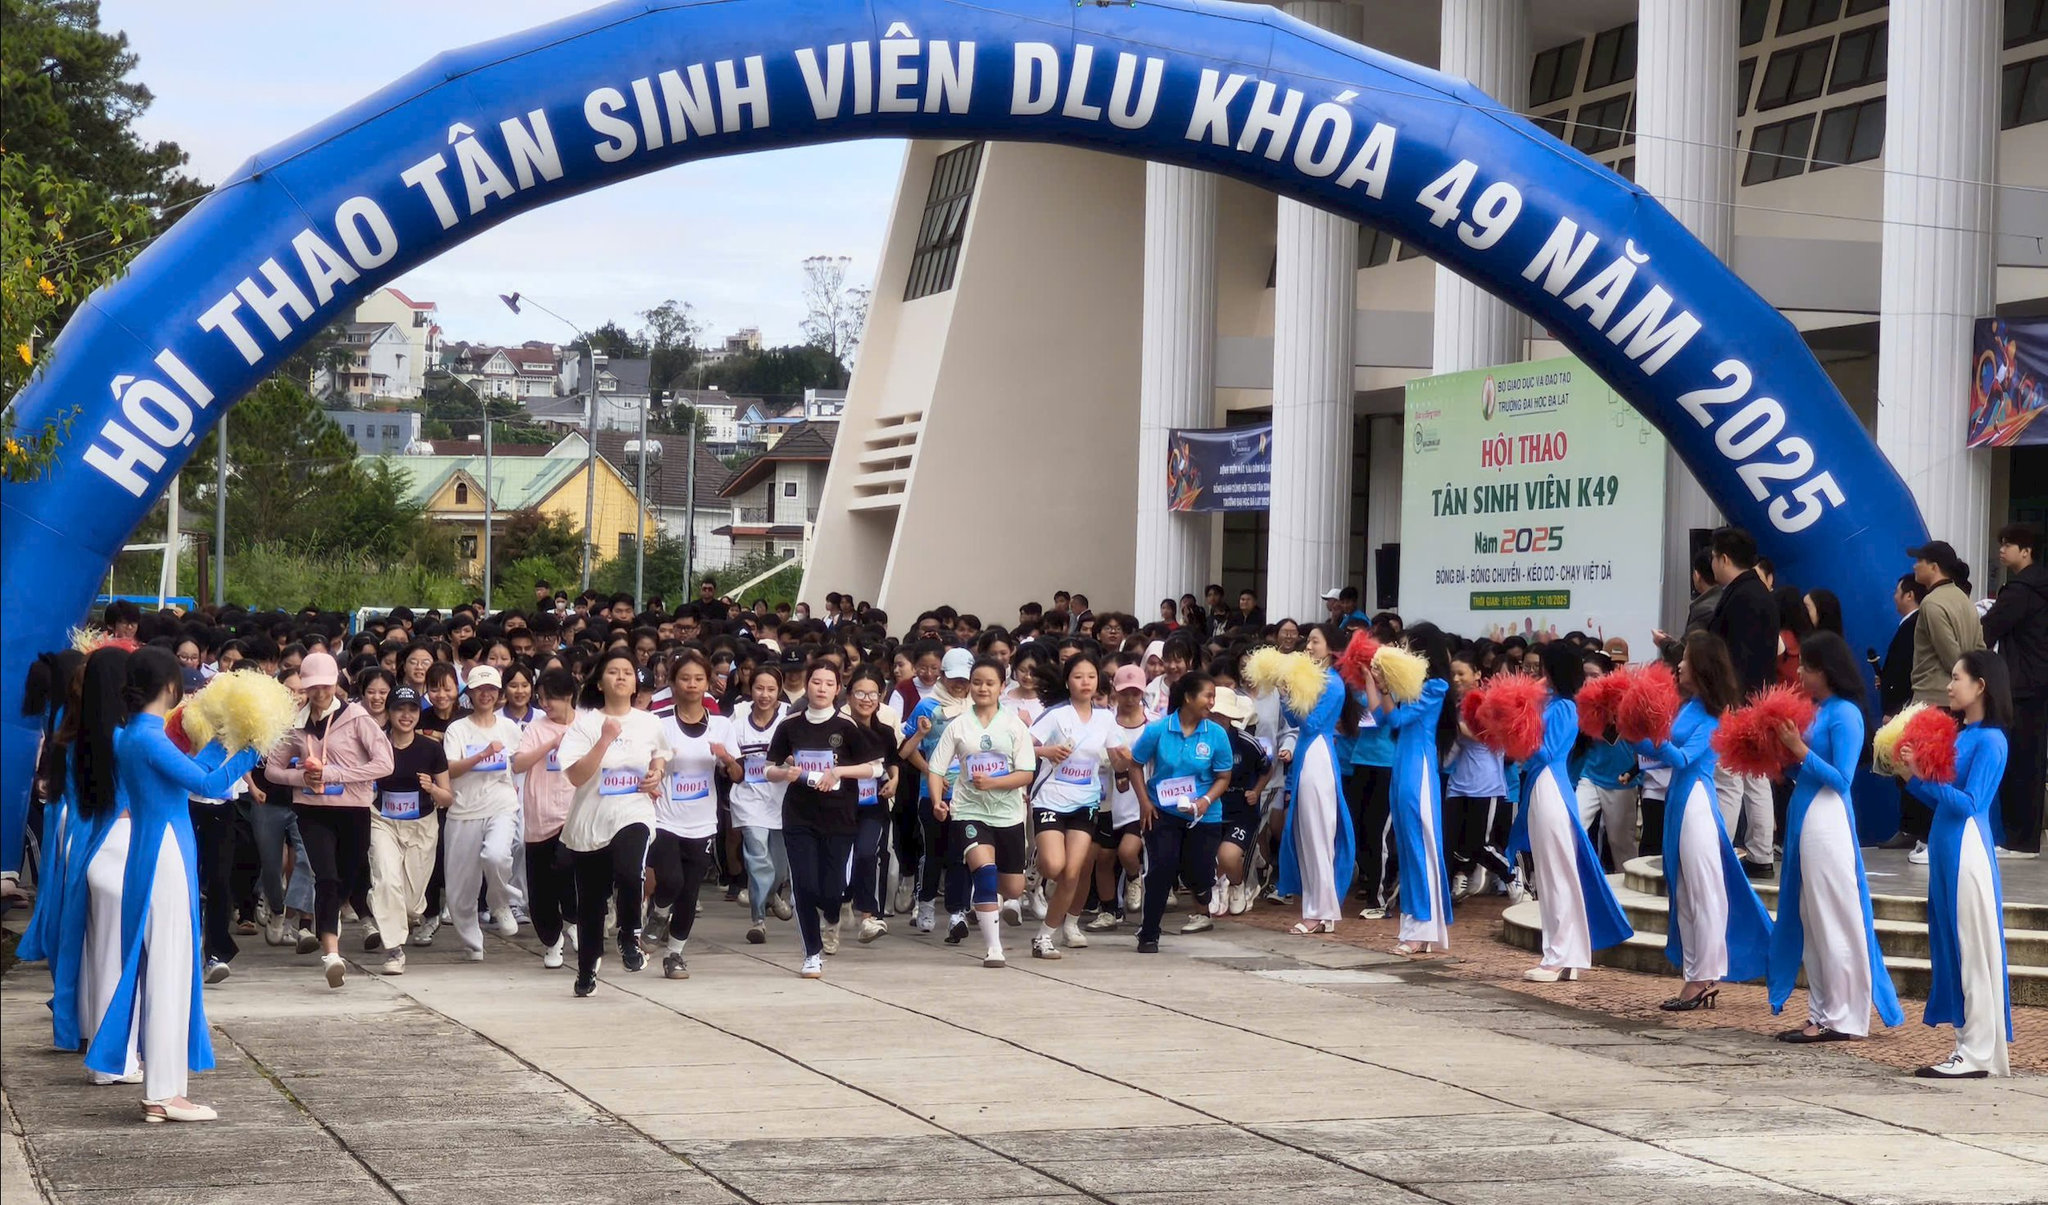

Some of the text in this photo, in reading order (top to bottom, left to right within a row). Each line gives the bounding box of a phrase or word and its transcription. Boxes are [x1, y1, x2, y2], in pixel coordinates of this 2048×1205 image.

[84, 22, 1845, 533] HỘI THAO TÂN SINH VIÊN DLU KHÓA 49 NĂM 2025
[1481, 431, 1567, 472] HỘI THAO
[1432, 474, 1618, 516] TÂN SINH VIÊN K49
[1475, 526, 1564, 554] Năm 2025
[1436, 566, 1454, 584] BÓNG
[1456, 566, 1465, 584] ĐÁ
[1470, 565, 1490, 583] BÓNG
[1527, 562, 1542, 582] KÉO
[1544, 566, 1554, 581] CO
[1560, 565, 1580, 584] CHẠY
[1582, 561, 1599, 584] VIỆT
[971, 762, 1005, 773] 00492
[604, 776, 640, 787] 00440
[676, 780, 707, 792] 00013
[860, 788, 874, 797] 480
[1161, 784, 1192, 798] 00234
[1231, 827, 1246, 840] 25
